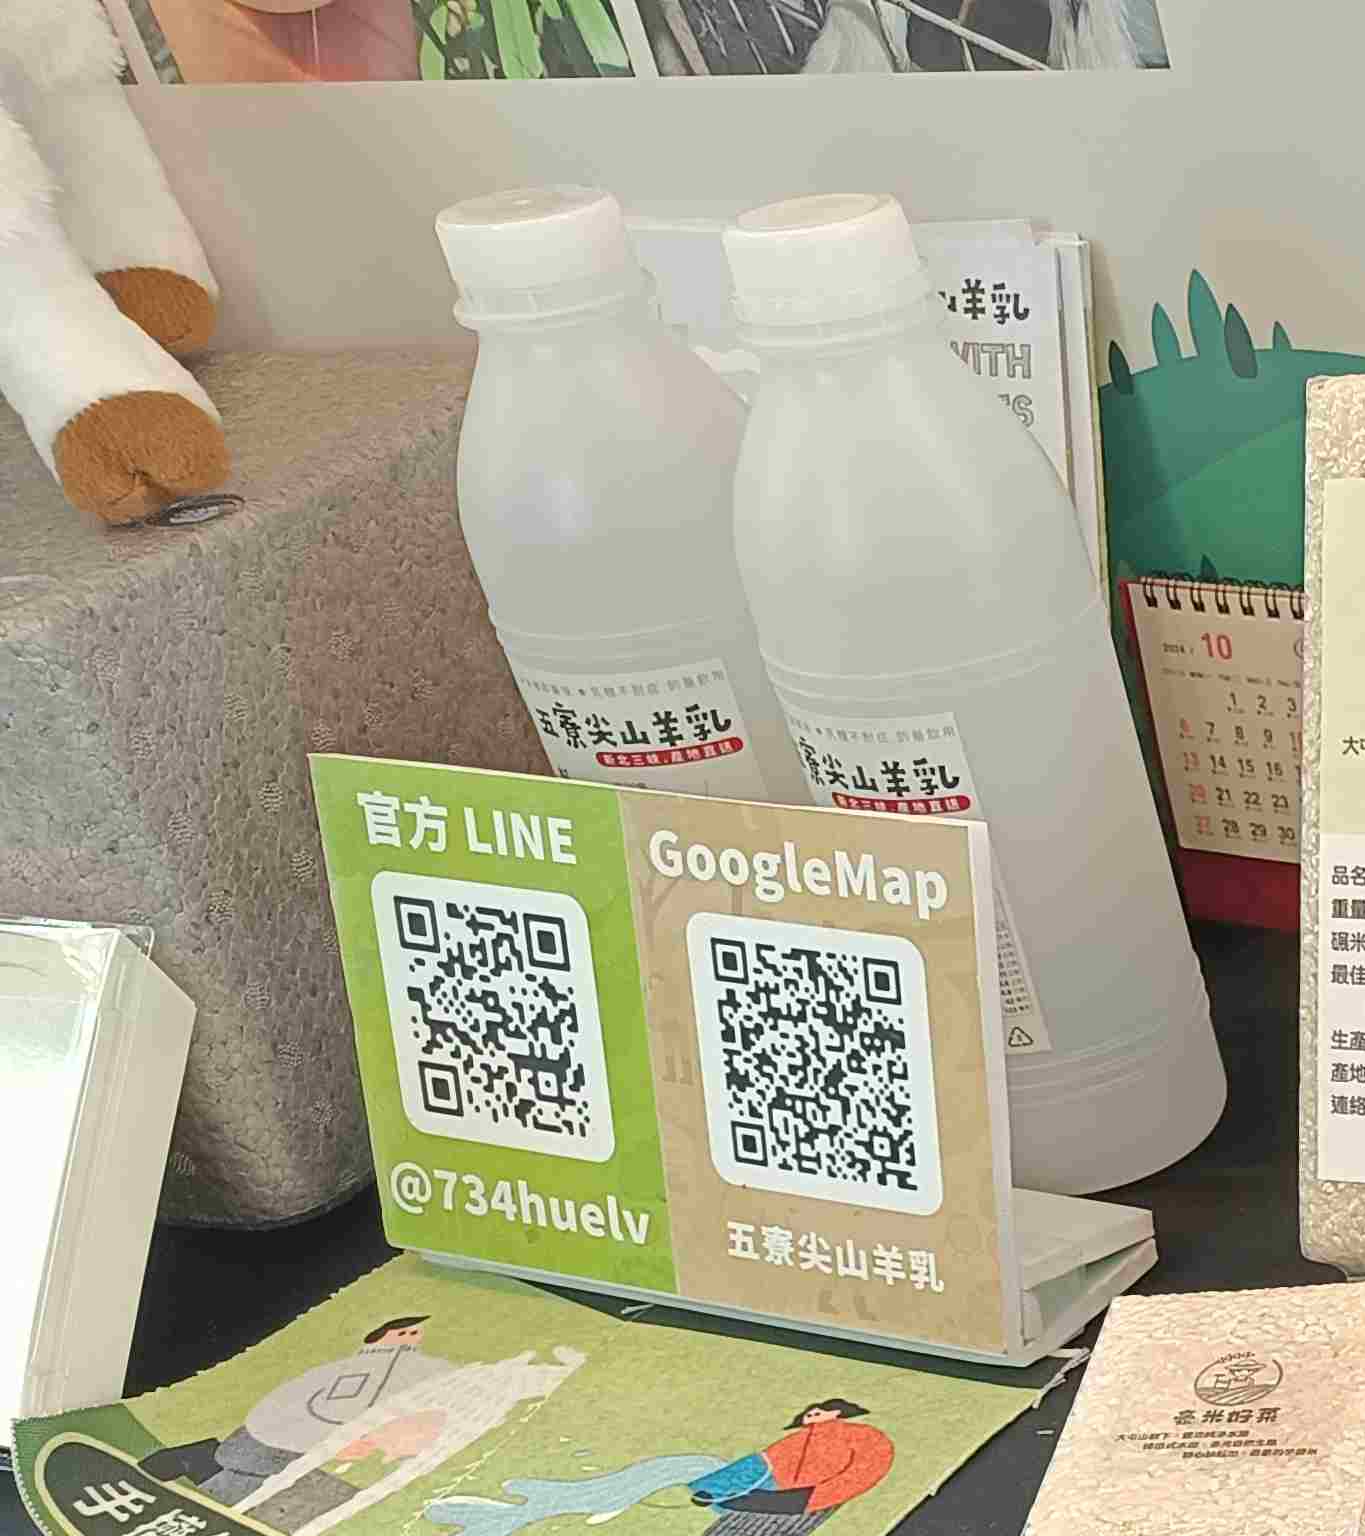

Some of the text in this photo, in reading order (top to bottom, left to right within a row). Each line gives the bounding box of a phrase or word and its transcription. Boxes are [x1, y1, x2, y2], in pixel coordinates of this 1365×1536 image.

[998, 393, 1034, 428] S
[1201, 632, 1233, 660] 10
[535, 702, 732, 749] 五寮尖山羊乳
[359, 792, 578, 866] 官方 LINE
[649, 830, 949, 920] GoogleMap
[391, 1162, 651, 1246] @734huelv
[727, 1221, 945, 1293] 五寮尖山羊乳
